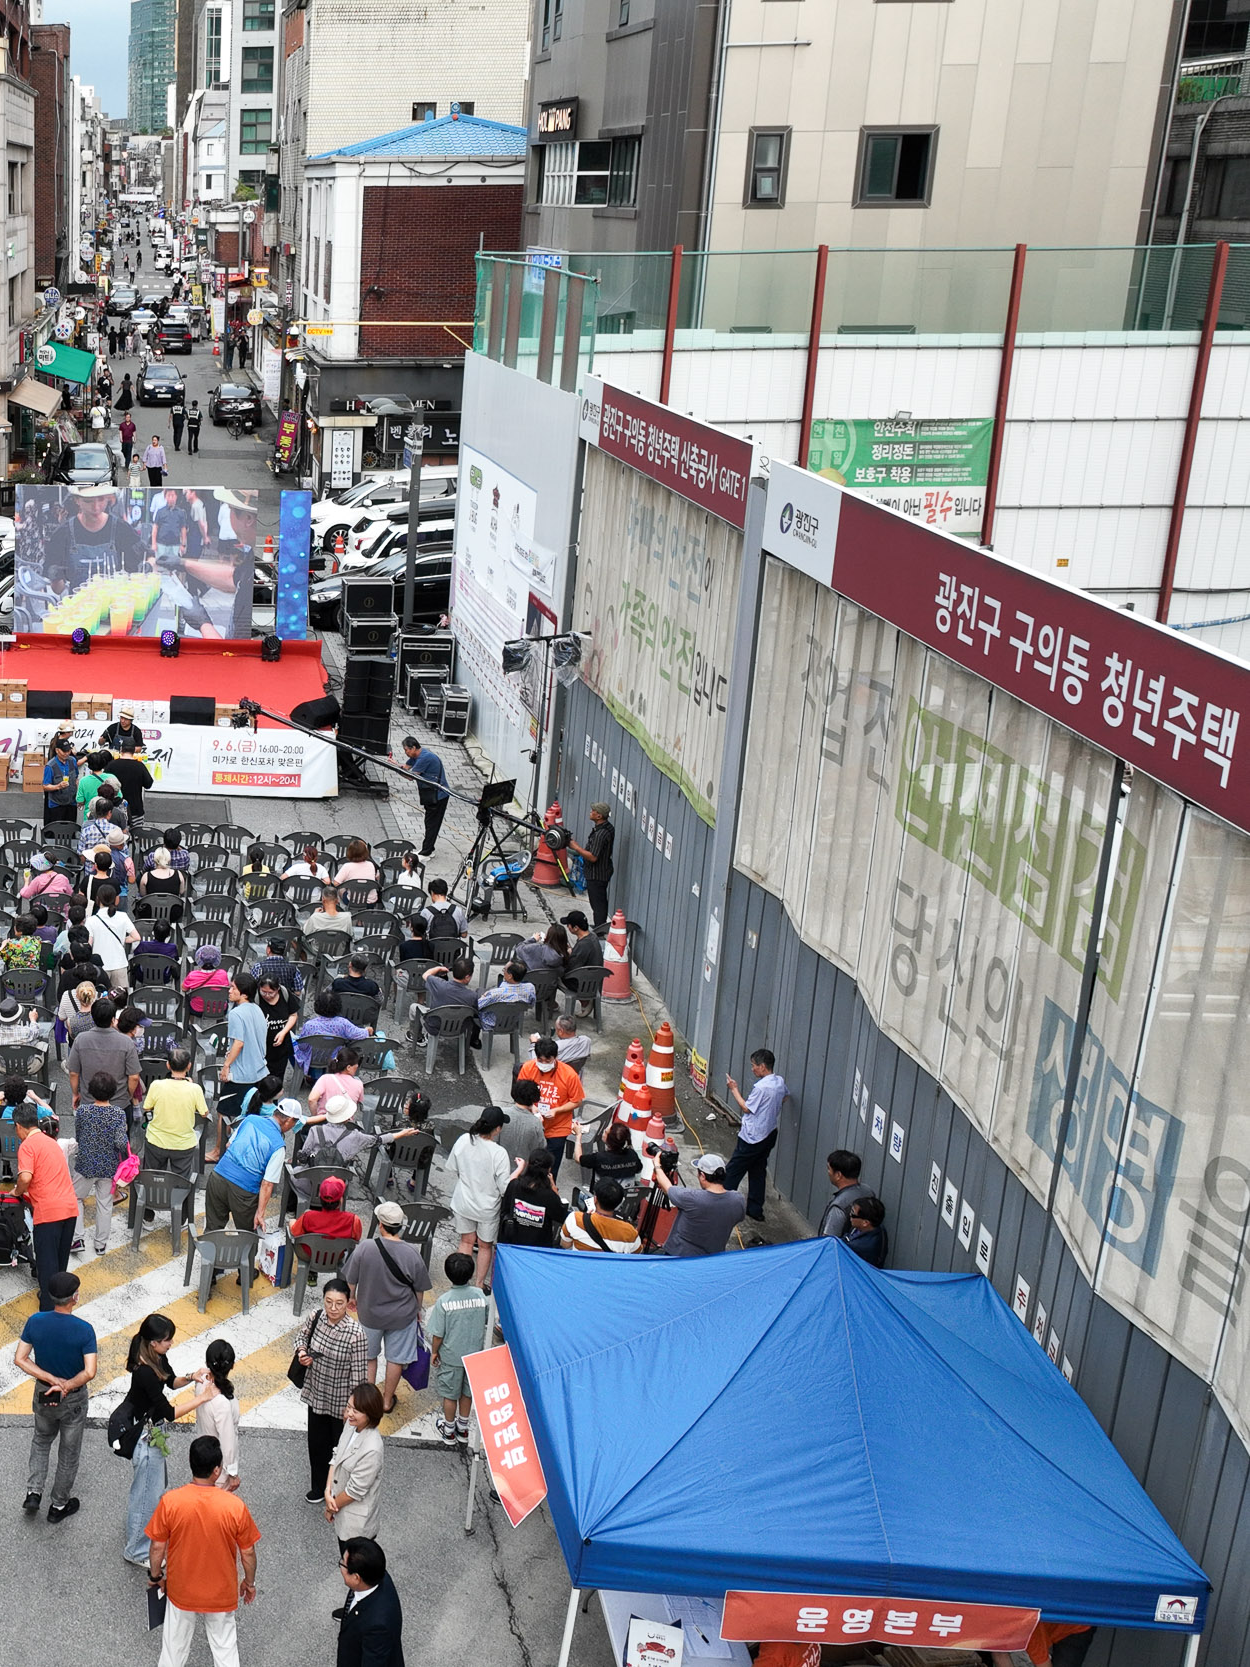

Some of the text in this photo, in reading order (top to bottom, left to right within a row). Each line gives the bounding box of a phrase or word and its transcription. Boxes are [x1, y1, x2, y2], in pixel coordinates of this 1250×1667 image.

[873, 421, 916, 438] 안전수칙
[602, 403, 747, 502] 광진구 구의동 청년주택 신축공사 GATE 1
[870, 444, 915, 462] 정리정돈
[854, 467, 888, 483] 보호구
[889, 466, 913, 484] 착용
[795, 508, 820, 536] 광진구
[903, 497, 922, 517] 아닌
[923, 491, 954, 525] 필수
[954, 497, 982, 517] 입니다
[619, 579, 660, 661] 가족의
[934, 571, 1241, 790] 광진구 구의동 청년주택
[212, 755, 238, 765] 미가로
[240, 756, 275, 767] 한신포차
[796, 1606, 963, 1637] 운영본부
